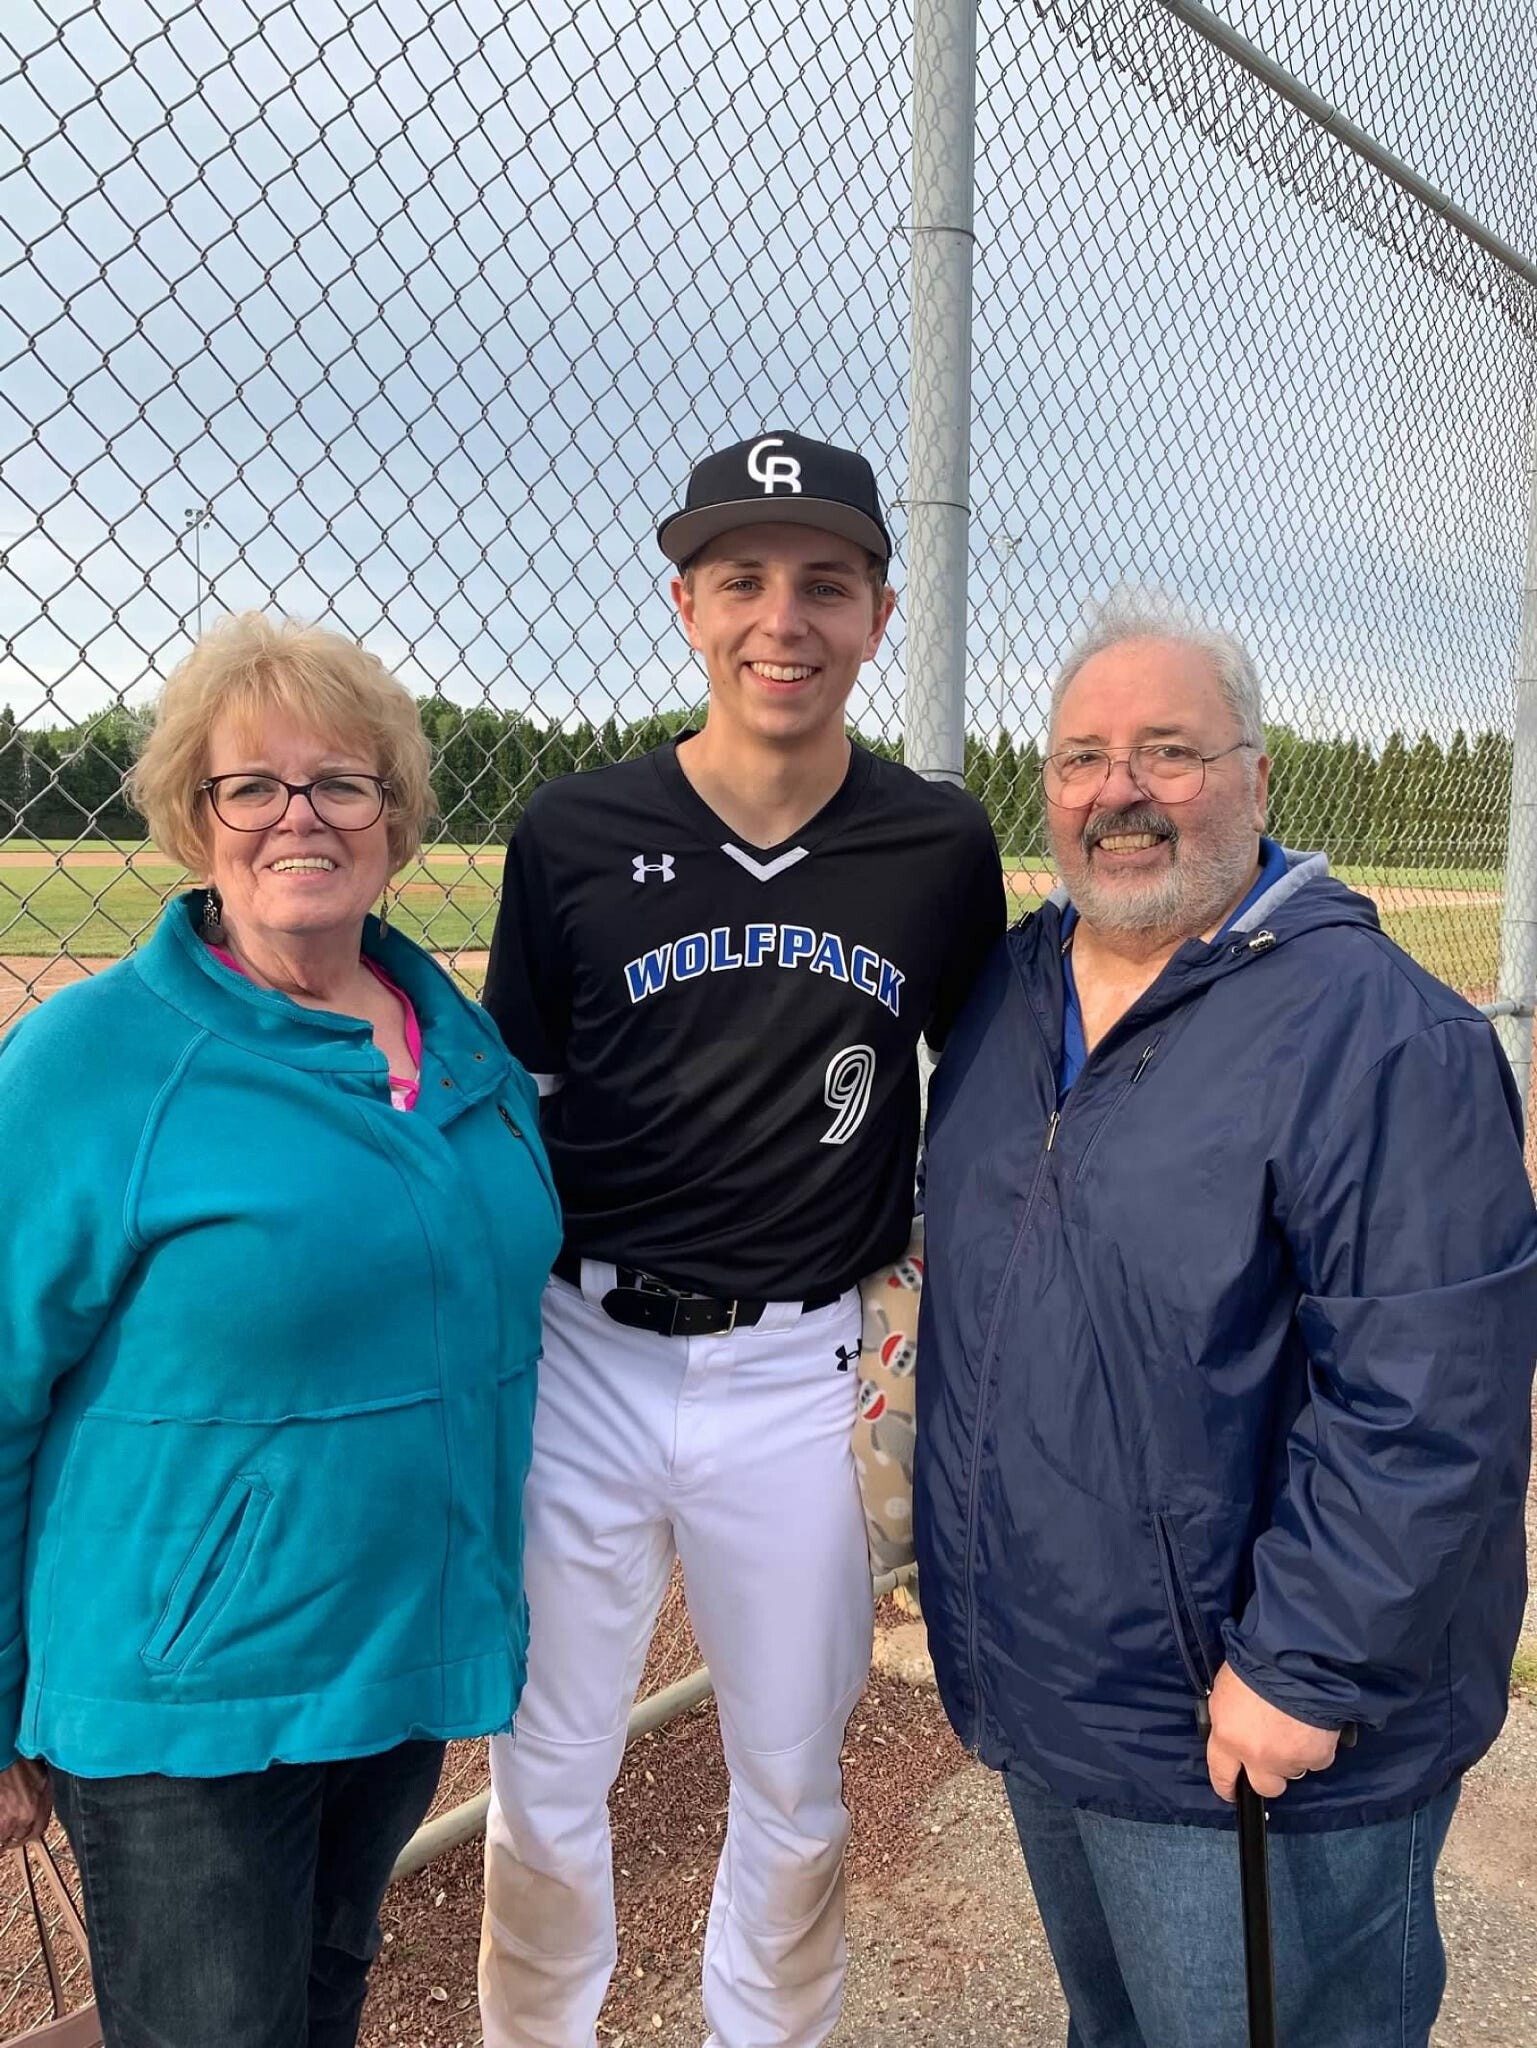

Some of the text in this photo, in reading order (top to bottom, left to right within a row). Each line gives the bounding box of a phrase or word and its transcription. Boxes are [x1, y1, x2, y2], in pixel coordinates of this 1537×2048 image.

[747, 438, 802, 494] CR
[624, 923, 906, 1018] WOLFPACK
[820, 1044, 877, 1145] 9
